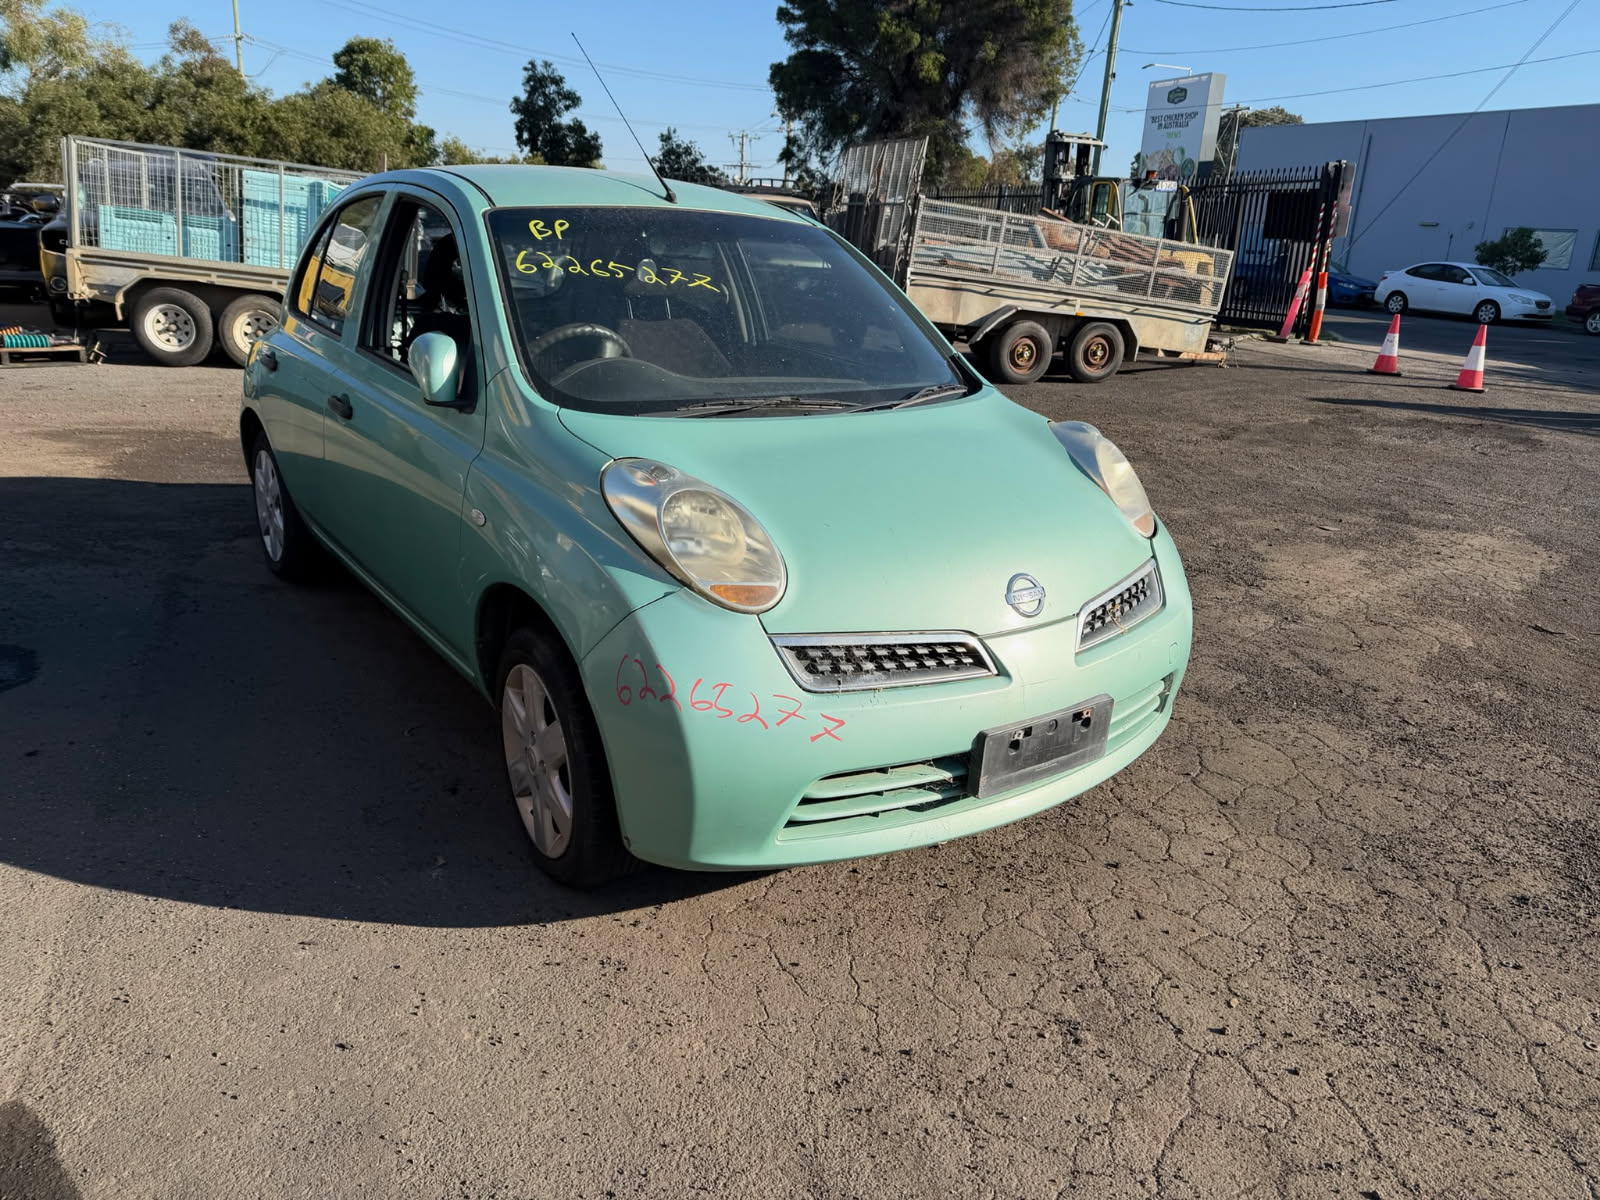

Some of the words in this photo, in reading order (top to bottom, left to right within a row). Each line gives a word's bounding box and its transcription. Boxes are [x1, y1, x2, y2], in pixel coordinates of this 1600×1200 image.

[529, 219, 570, 240] BP
[1012, 589, 1044, 602] NISSAN
[616, 655, 846, 742] 62265277
